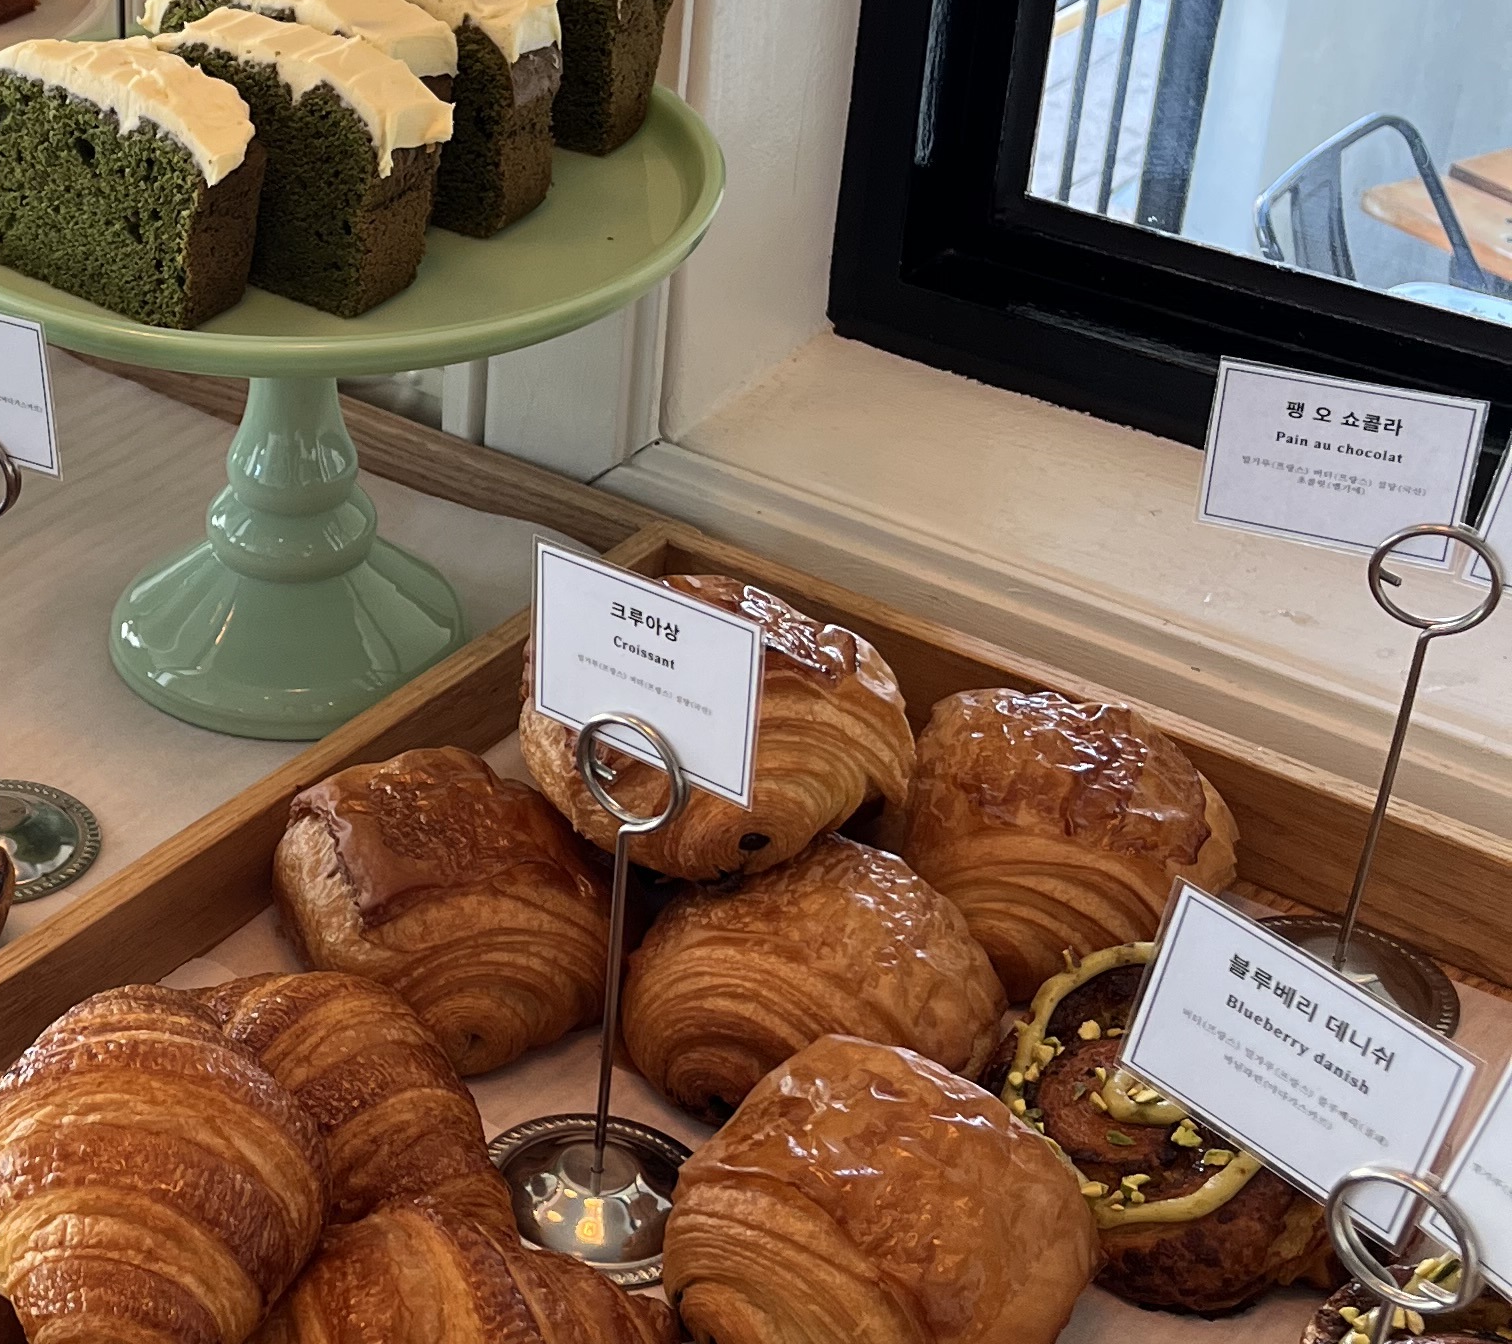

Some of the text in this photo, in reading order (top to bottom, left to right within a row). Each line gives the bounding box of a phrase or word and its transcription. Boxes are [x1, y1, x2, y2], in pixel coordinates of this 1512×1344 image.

[1286, 401, 1403, 436] 팽 오 쇼콜라
[1275, 431, 1403, 463] Pain au chocolat
[610, 600, 679, 642] 크루아상
[613, 635, 674, 670] Croissant
[1228, 952, 1396, 1072] 블루베리 데니쉬
[1225, 994, 1370, 1095] Blueberry danish
